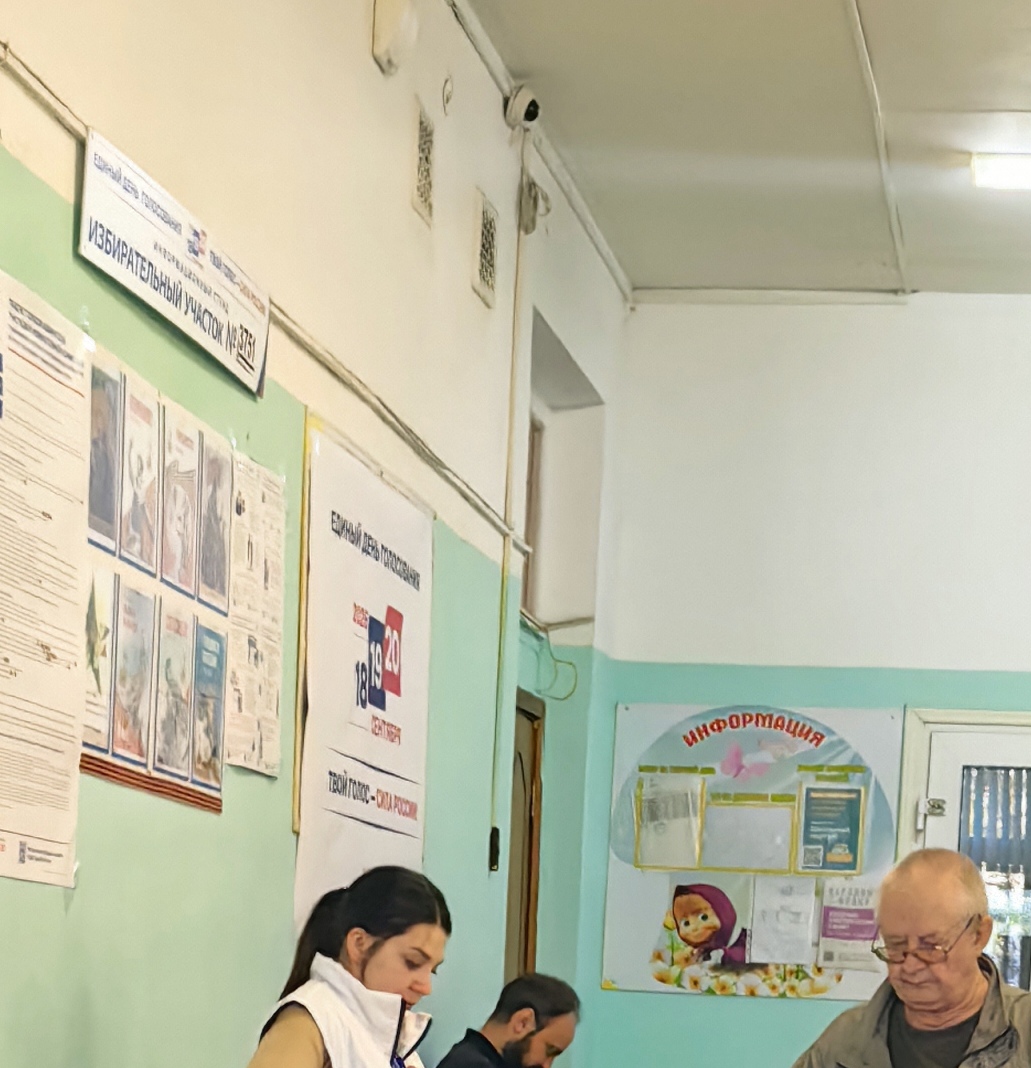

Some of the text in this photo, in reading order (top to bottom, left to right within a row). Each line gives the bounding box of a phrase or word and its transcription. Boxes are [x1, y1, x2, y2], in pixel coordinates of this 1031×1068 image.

[88, 216, 183, 311] ИЗБИРАТЕЛЬНЫЙ
[183, 290, 224, 347] УЧАСТОК
[331, 510, 362, 551] ЕДИНЫЙ
[361, 531, 380, 562] ДЕНЬ
[355, 624, 401, 710] 18 19 20
[682, 712, 826, 748] ИНФОРМАЦИЯ
[328, 769, 348, 798] ТВОЙ
[347, 777, 371, 805] ГОЛОС
